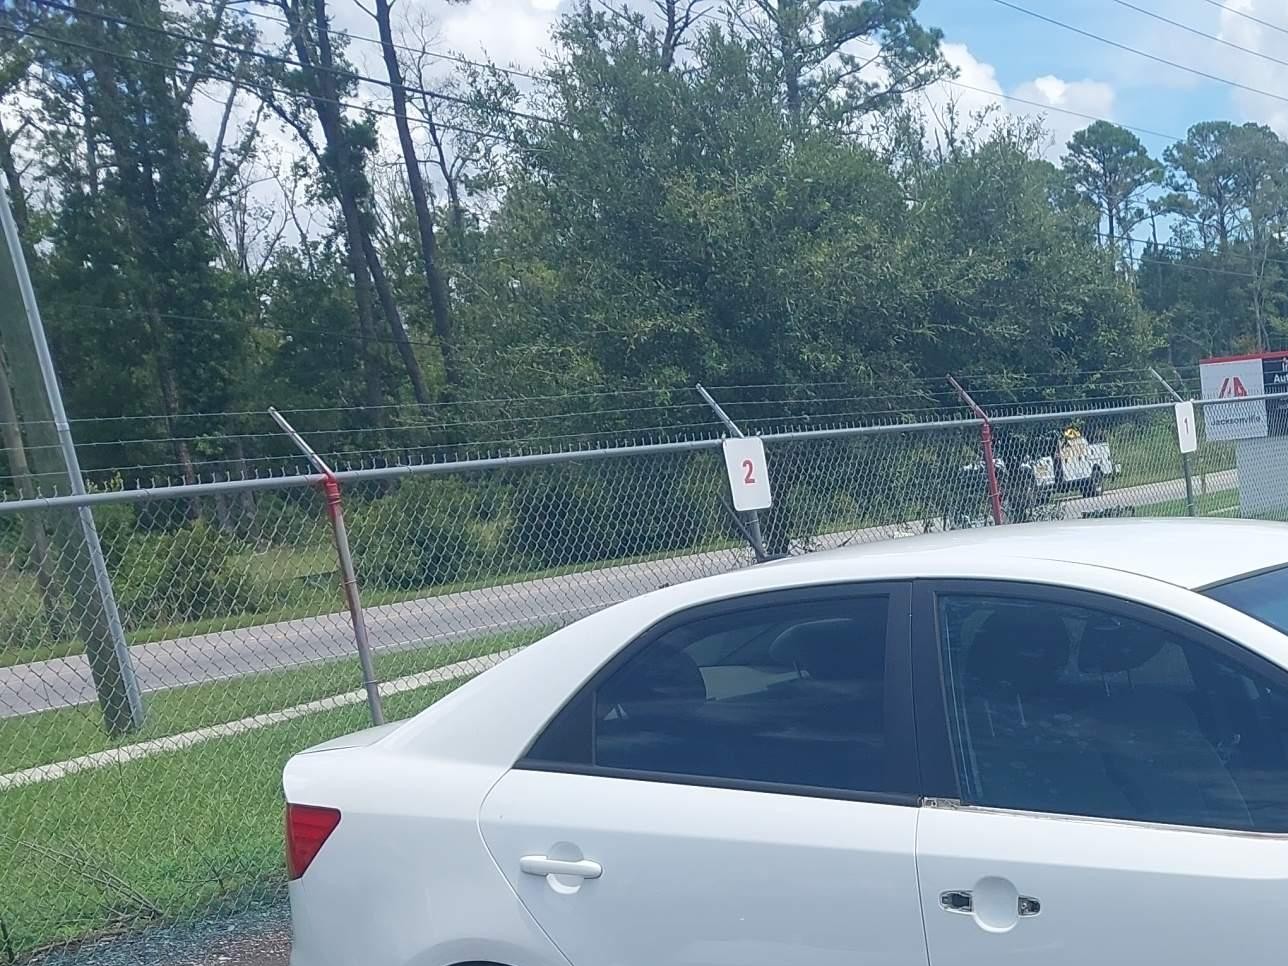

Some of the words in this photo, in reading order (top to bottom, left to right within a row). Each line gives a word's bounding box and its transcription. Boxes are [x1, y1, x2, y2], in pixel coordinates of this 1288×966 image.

[1183, 416, 1190, 434] 1
[1210, 414, 1261, 426] Jacksonville
[742, 459, 756, 484] 2
